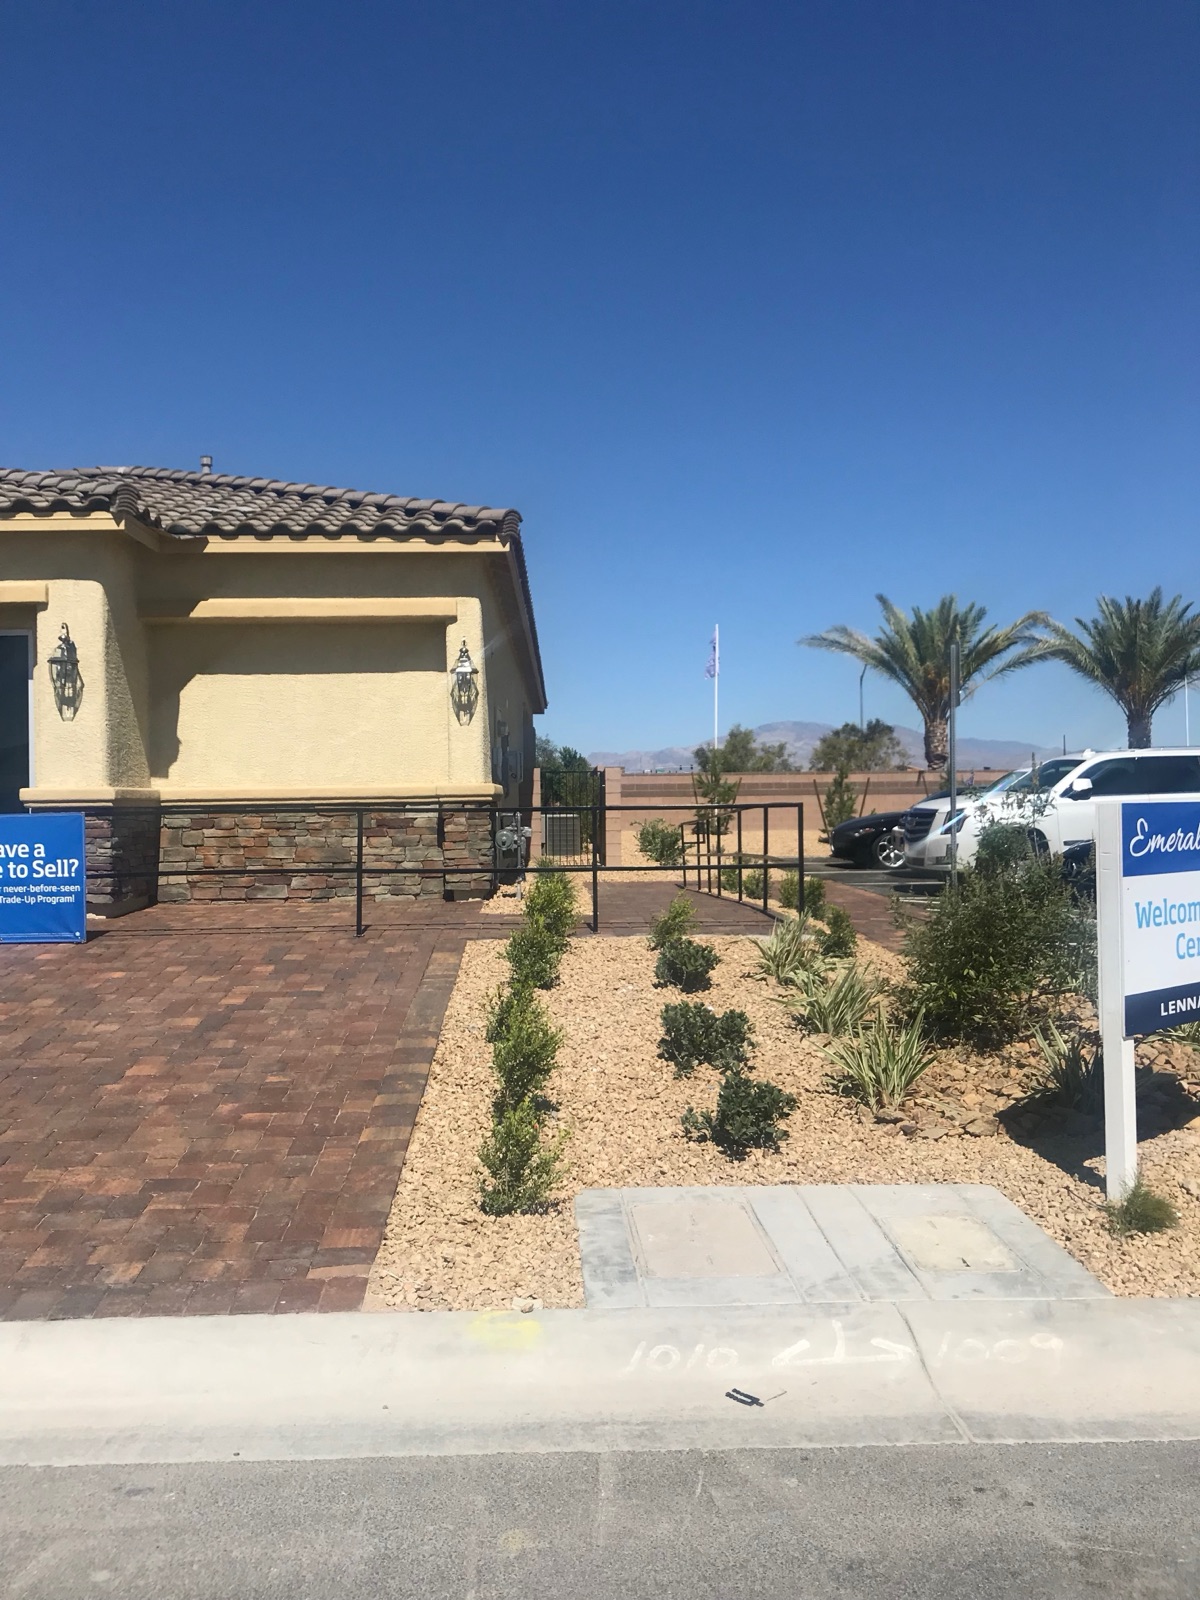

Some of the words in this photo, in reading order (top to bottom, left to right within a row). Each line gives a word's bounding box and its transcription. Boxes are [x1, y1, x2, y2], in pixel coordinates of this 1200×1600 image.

[33, 843, 45, 858] a
[7, 861, 28, 878] to
[32, 859, 79, 878] Sell?
[3, 884, 80, 893] never-before-seen
[37, 894, 75, 905] Program!
[621, 1341, 739, 1374] 1010
[936, 1331, 1064, 1374] 1009
